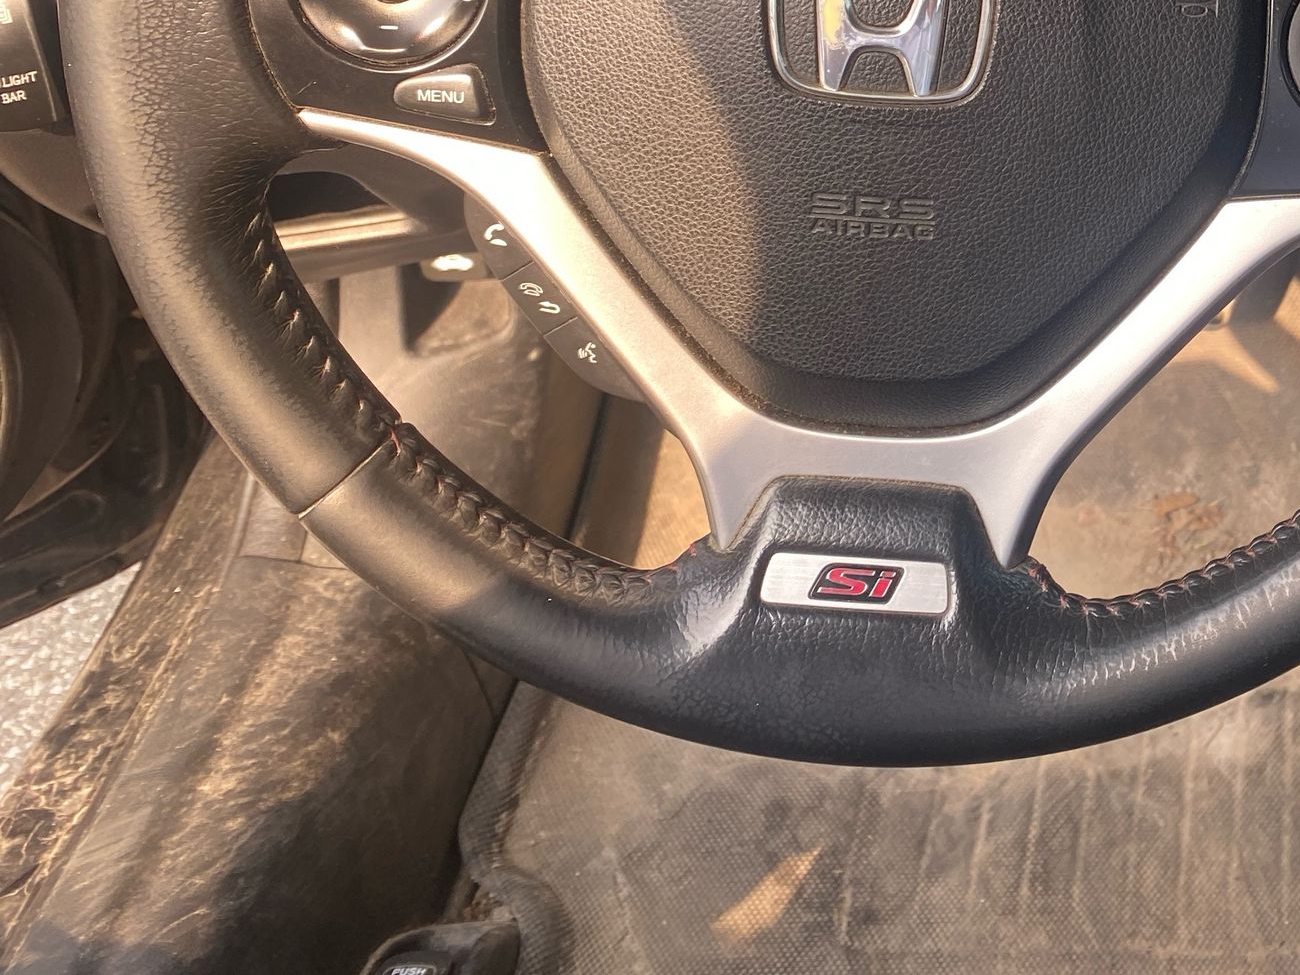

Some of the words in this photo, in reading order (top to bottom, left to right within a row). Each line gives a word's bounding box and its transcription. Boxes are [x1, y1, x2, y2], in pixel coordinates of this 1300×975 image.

[2, 71, 38, 88] LIGHT
[1, 90, 28, 105] BAR
[416, 88, 465, 104] MENU
[811, 192, 936, 219] SRS
[811, 221, 936, 241] AIRBAG
[816, 568, 897, 598] Si
